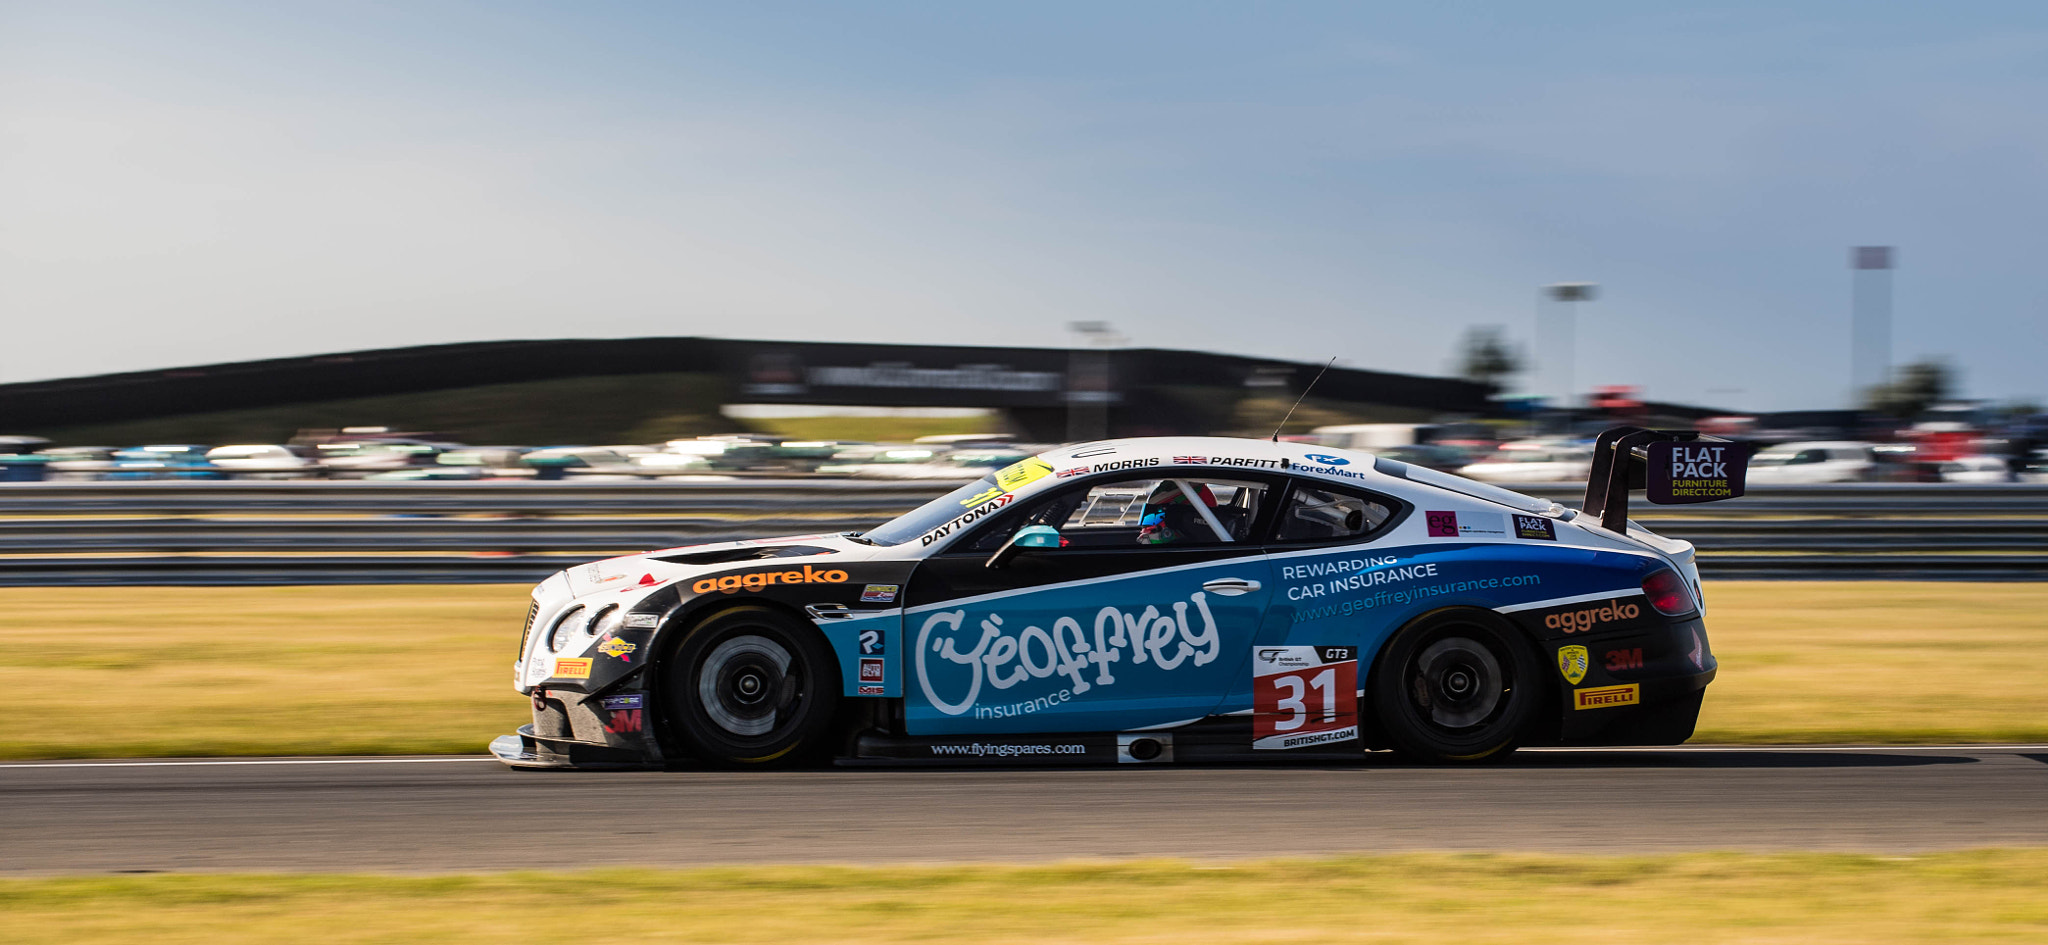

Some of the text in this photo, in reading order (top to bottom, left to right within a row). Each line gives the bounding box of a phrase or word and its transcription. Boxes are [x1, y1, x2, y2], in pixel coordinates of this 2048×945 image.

[1210, 456, 1280, 469] PARFITT
[1672, 447, 1725, 462] FLAT
[1093, 457, 1160, 473] MORRIS
[1291, 462, 1365, 480] ForexMart
[1672, 463, 1728, 478] PACK
[1672, 488, 1732, 496] DIRECT.COM
[921, 501, 1000, 548] DAYTONA
[1518, 516, 1544, 525] FLAT
[1520, 522, 1547, 531] PACK
[1282, 555, 1398, 580] REWARDING
[692, 565, 849, 595] aggreko
[1287, 563, 1439, 601] CAR INSURANCE
[1290, 573, 1541, 624] www.geoffreyinsurance.com
[1545, 599, 1640, 634] aggreko
[1325, 648, 1349, 659] GT3
[1605, 648, 1643, 671] 3M
[556, 661, 588, 675] PIRELLI
[975, 689, 1071, 720] insurance
[1273, 668, 1336, 731] 31
[1579, 687, 1634, 706] PIRELLI
[604, 709, 642, 734] 3M
[1283, 729, 1355, 747] BRITISHGT.COM
[931, 742, 1086, 757] www.flyingspares.com
